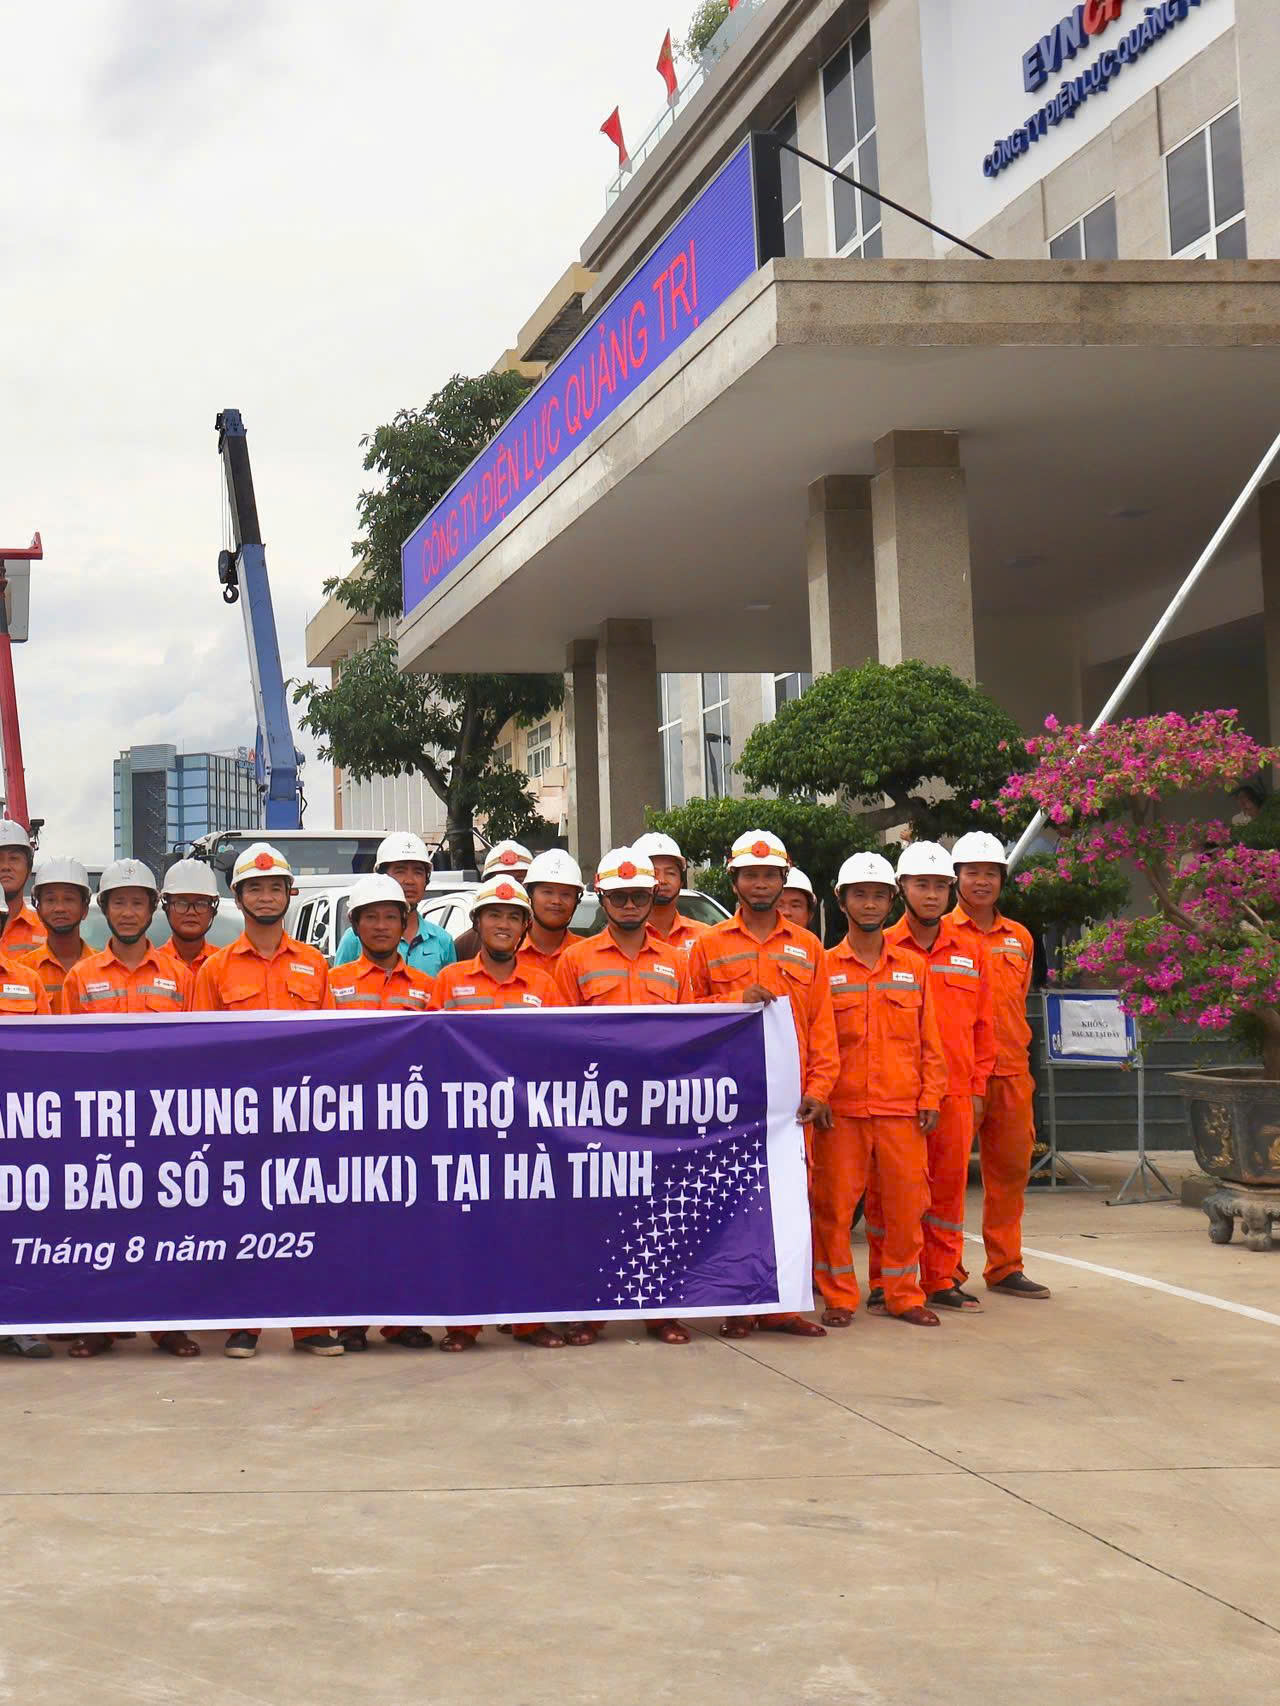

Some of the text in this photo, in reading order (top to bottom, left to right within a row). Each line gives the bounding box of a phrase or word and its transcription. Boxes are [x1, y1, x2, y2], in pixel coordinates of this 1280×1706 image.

[983, 128, 1029, 177] CÔNG
[1023, 108, 1048, 141] TY
[422, 239, 700, 585] CÔNG TY ĐIỆN LỰC QUẢNG TRỊ
[74, 1089, 136, 1148] TRỊ
[149, 1087, 259, 1137] XUNG
[272, 1075, 364, 1133] KÍCH
[377, 1064, 429, 1130] HỖ
[441, 1076, 515, 1139] TRỢ
[526, 1062, 629, 1128] KHẮC
[641, 1076, 739, 1134] PHỤC
[64, 1153, 144, 1210] BÃO
[157, 1143, 211, 1208] SỐ
[222, 1160, 246, 1207] 5
[260, 1155, 417, 1211] (KAJIKI)
[431, 1153, 490, 1212] TẠI
[504, 1142, 556, 1200] HÀ
[567, 1141, 655, 1199] TĨNH
[11, 1231, 316, 1271] Tháng 8 năm 2025
